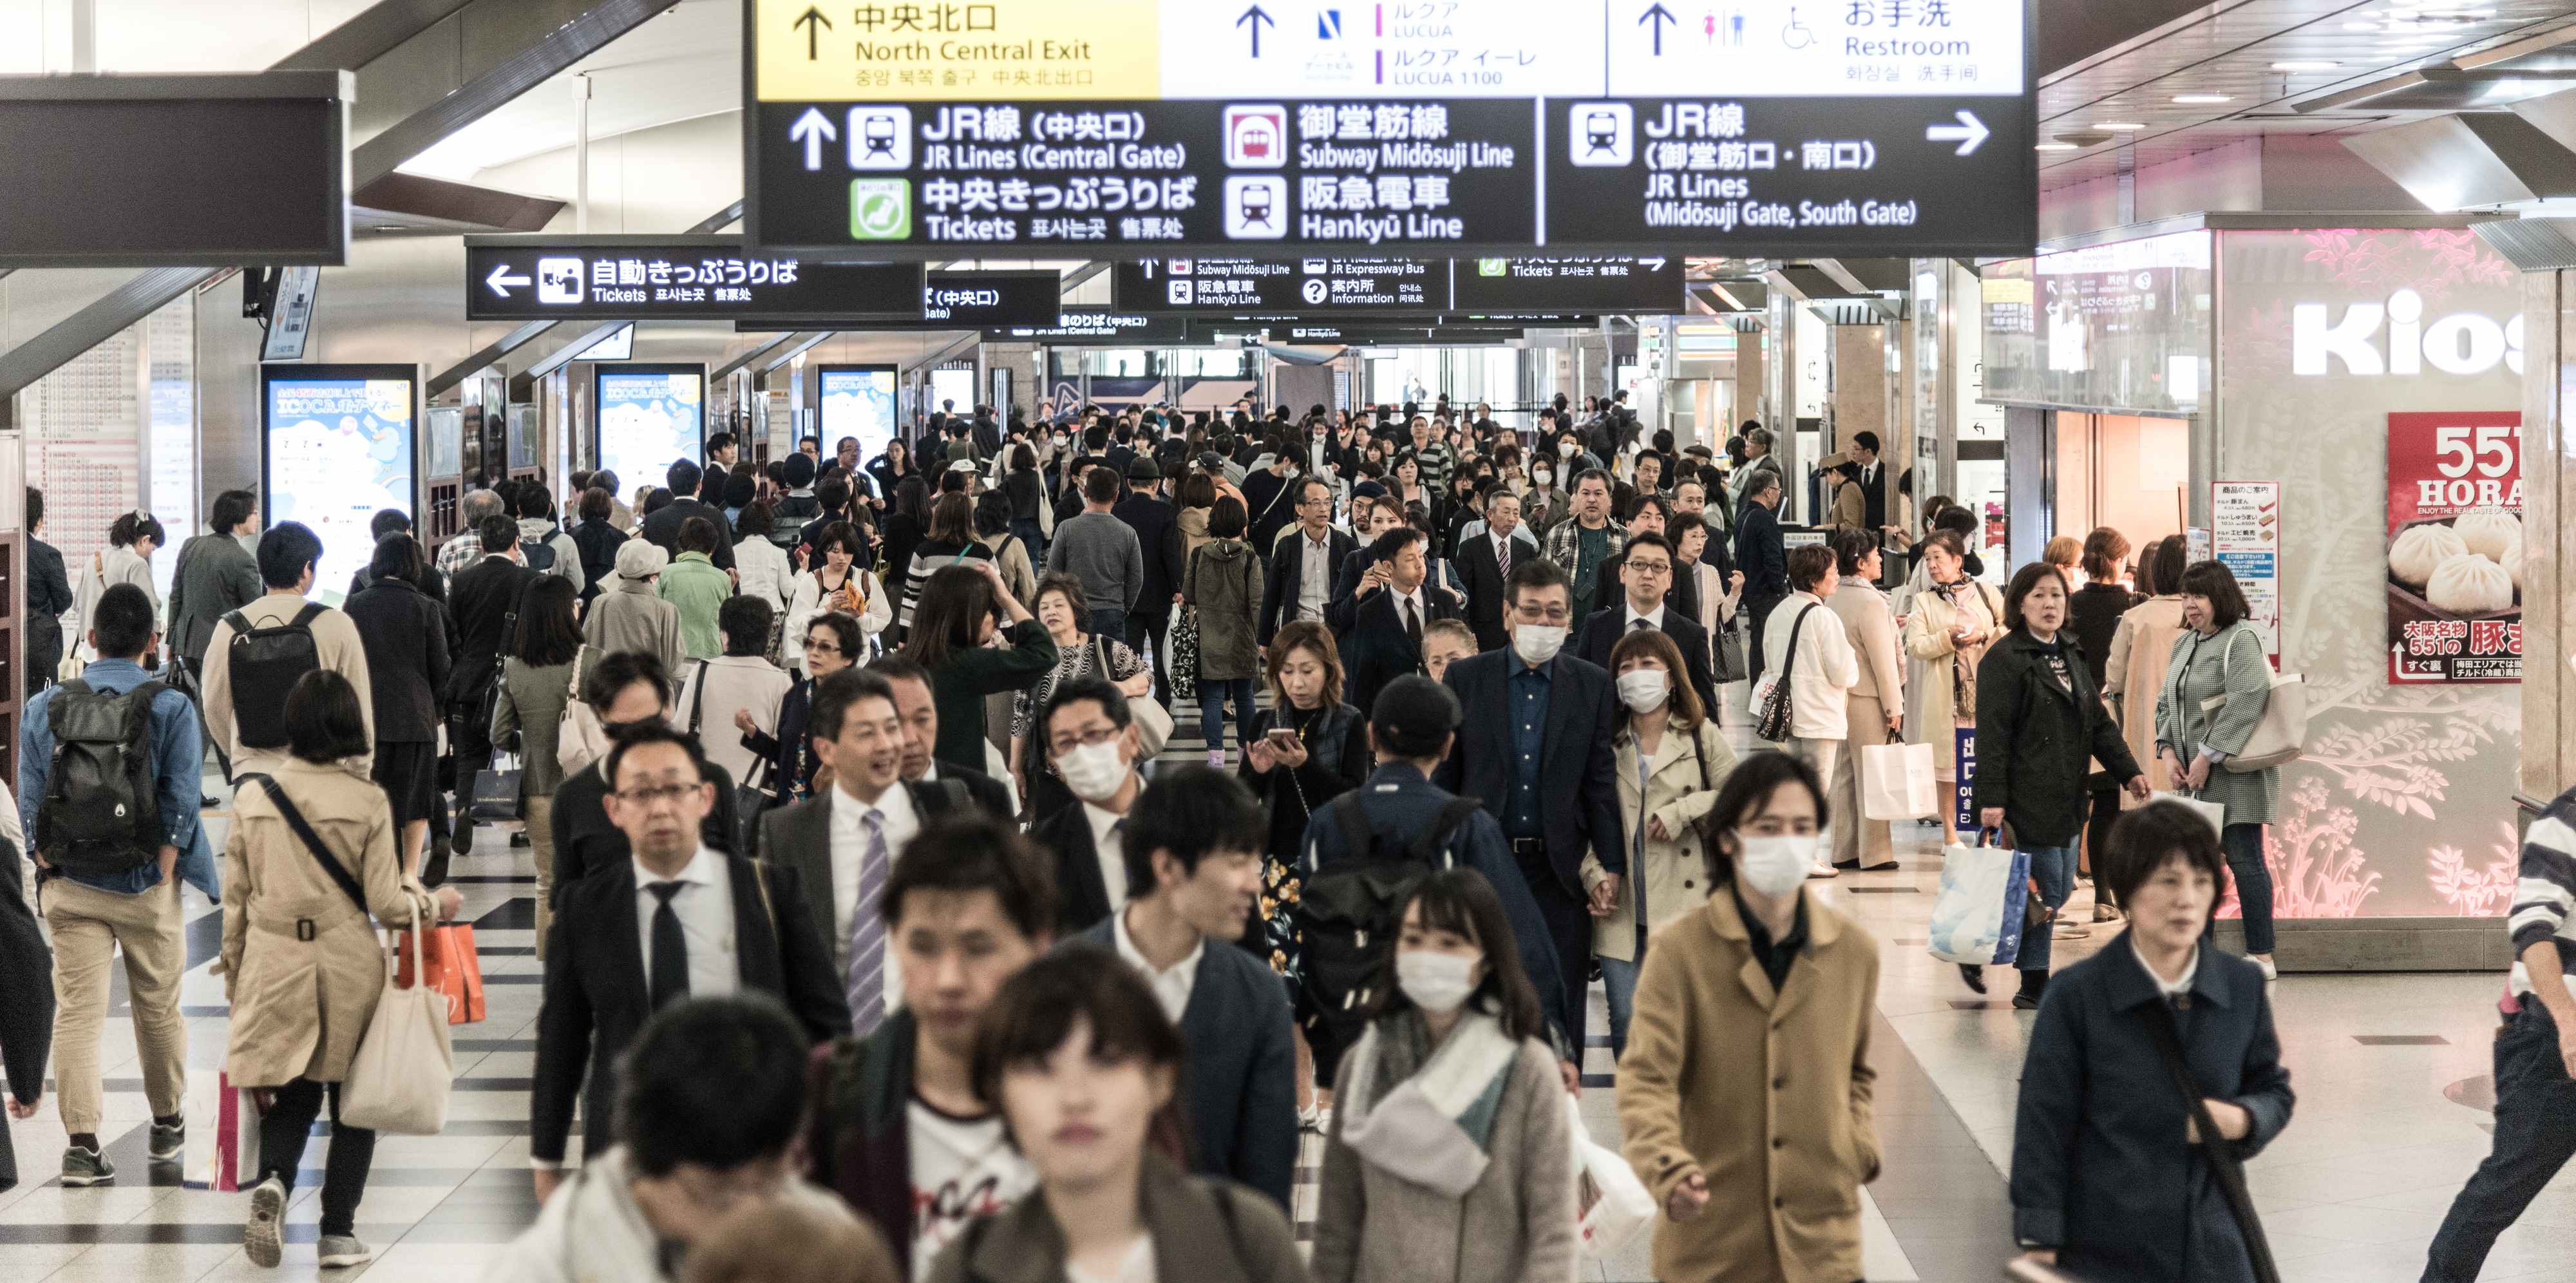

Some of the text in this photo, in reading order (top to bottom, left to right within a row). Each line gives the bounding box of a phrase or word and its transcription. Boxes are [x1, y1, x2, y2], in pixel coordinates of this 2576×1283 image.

[855, 4, 995, 32] 中央北口
[1395, 3, 1458, 19] ルクア
[1846, 0, 1950, 27] お手洗
[1395, 25, 1452, 37] LUCUA
[857, 40, 1090, 61] North Central Exit
[1846, 37, 1969, 55] Restroom
[1395, 50, 1535, 66] ルクア イーレ
[856, 69, 976, 86] 중앙 북쪽 출구
[993, 69, 1092, 85] 中央北出口
[1395, 72, 1502, 84] LUCUA 1100
[1846, 66, 1899, 81] 화장실
[1298, 104, 1448, 140] 御堂筋線
[1645, 103, 1744, 138] JR線
[923, 143, 1185, 169] JR Lines (Central Gate)
[1300, 142, 1513, 173] Subway Midōsuji Line
[923, 176, 1197, 211] 中央きっぷうりば
[1302, 175, 1449, 210] 阪急電車
[1645, 174, 1748, 198] JR Lines
[1645, 200, 1916, 231] (Midōsuji Gate, South Gate)
[925, 214, 1016, 240] Tickets
[1121, 218, 1183, 238] 售票处
[1302, 213, 1463, 244] Hankyū Line
[593, 259, 798, 285] 自動きっぷうりば
[1197, 263, 1291, 277] Subway Midōsuji Line
[1331, 264, 1425, 276] JR Expressway Bus
[1511, 265, 1553, 277] Tickets
[714, 288, 751, 301] 售票处
[1198, 280, 1255, 293] 阪急電車
[1332, 280, 1374, 292] 案内所
[592, 288, 647, 302] Tickets
[1198, 294, 1262, 307] Hankyū Line
[1332, 294, 1394, 304] Information
[2222, 486, 2269, 494] 商品のご案内
[2403, 620, 2468, 639] 大阪名物
[2409, 638, 2462, 656] 551の
[2407, 660, 2442, 672] すぐ裏
